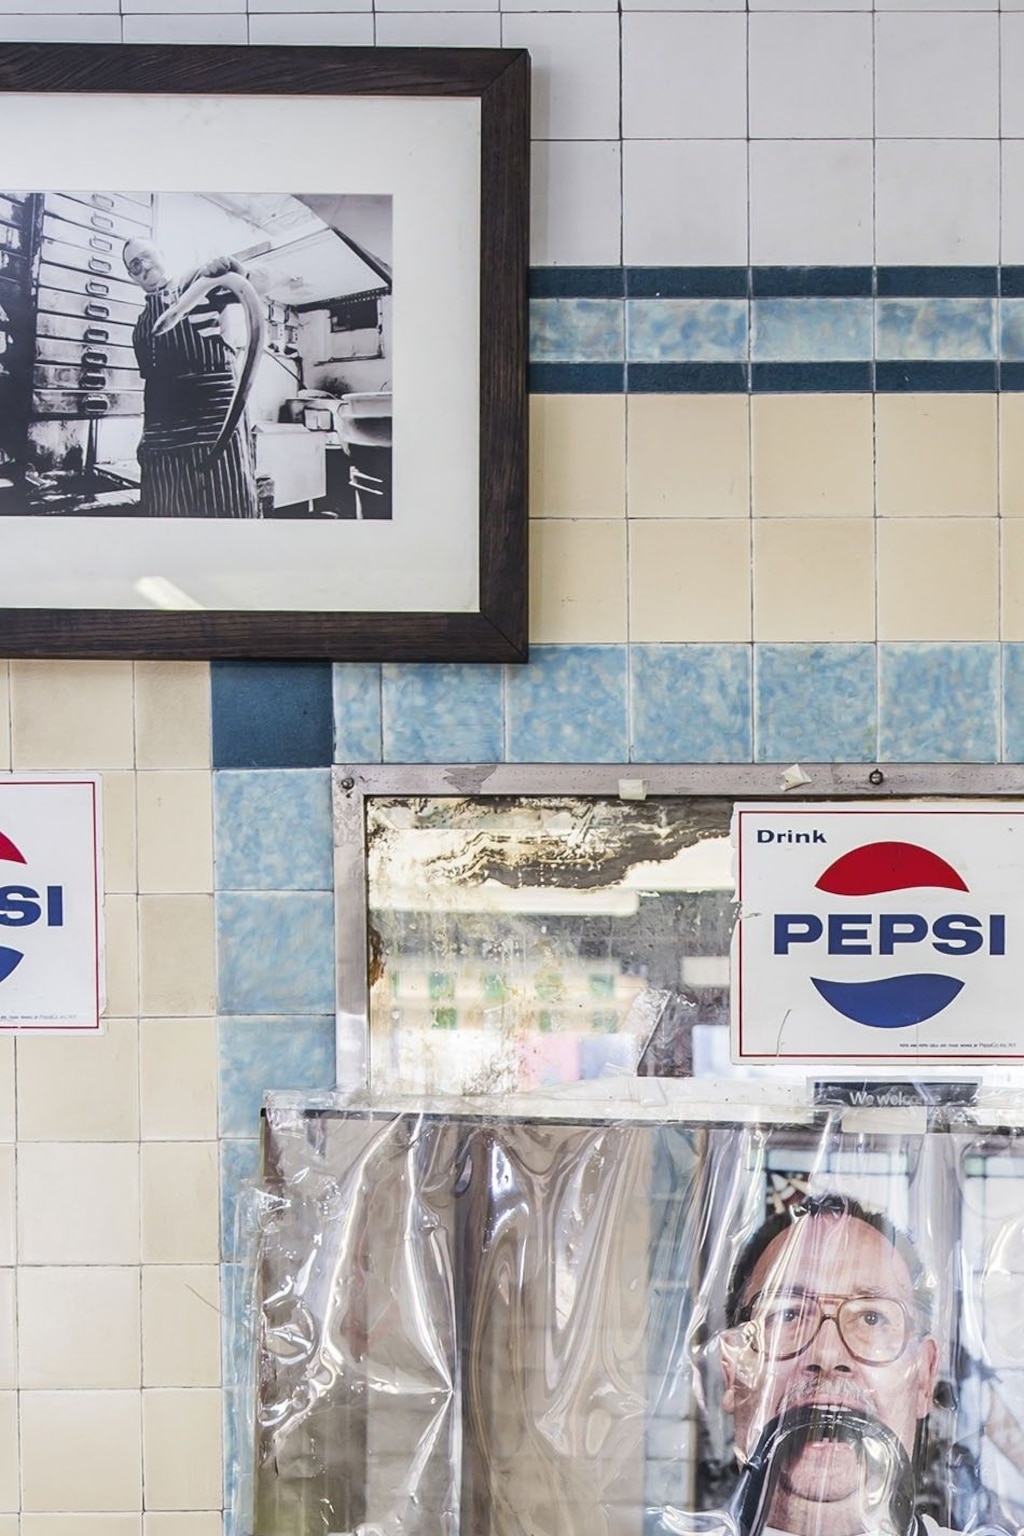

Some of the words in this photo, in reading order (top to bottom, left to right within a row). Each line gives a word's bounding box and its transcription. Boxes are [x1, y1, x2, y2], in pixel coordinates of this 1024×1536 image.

[757, 829, 827, 843] Drink
[774, 914, 1005, 955] PEPSI
[849, 1092, 874, 1105] We
